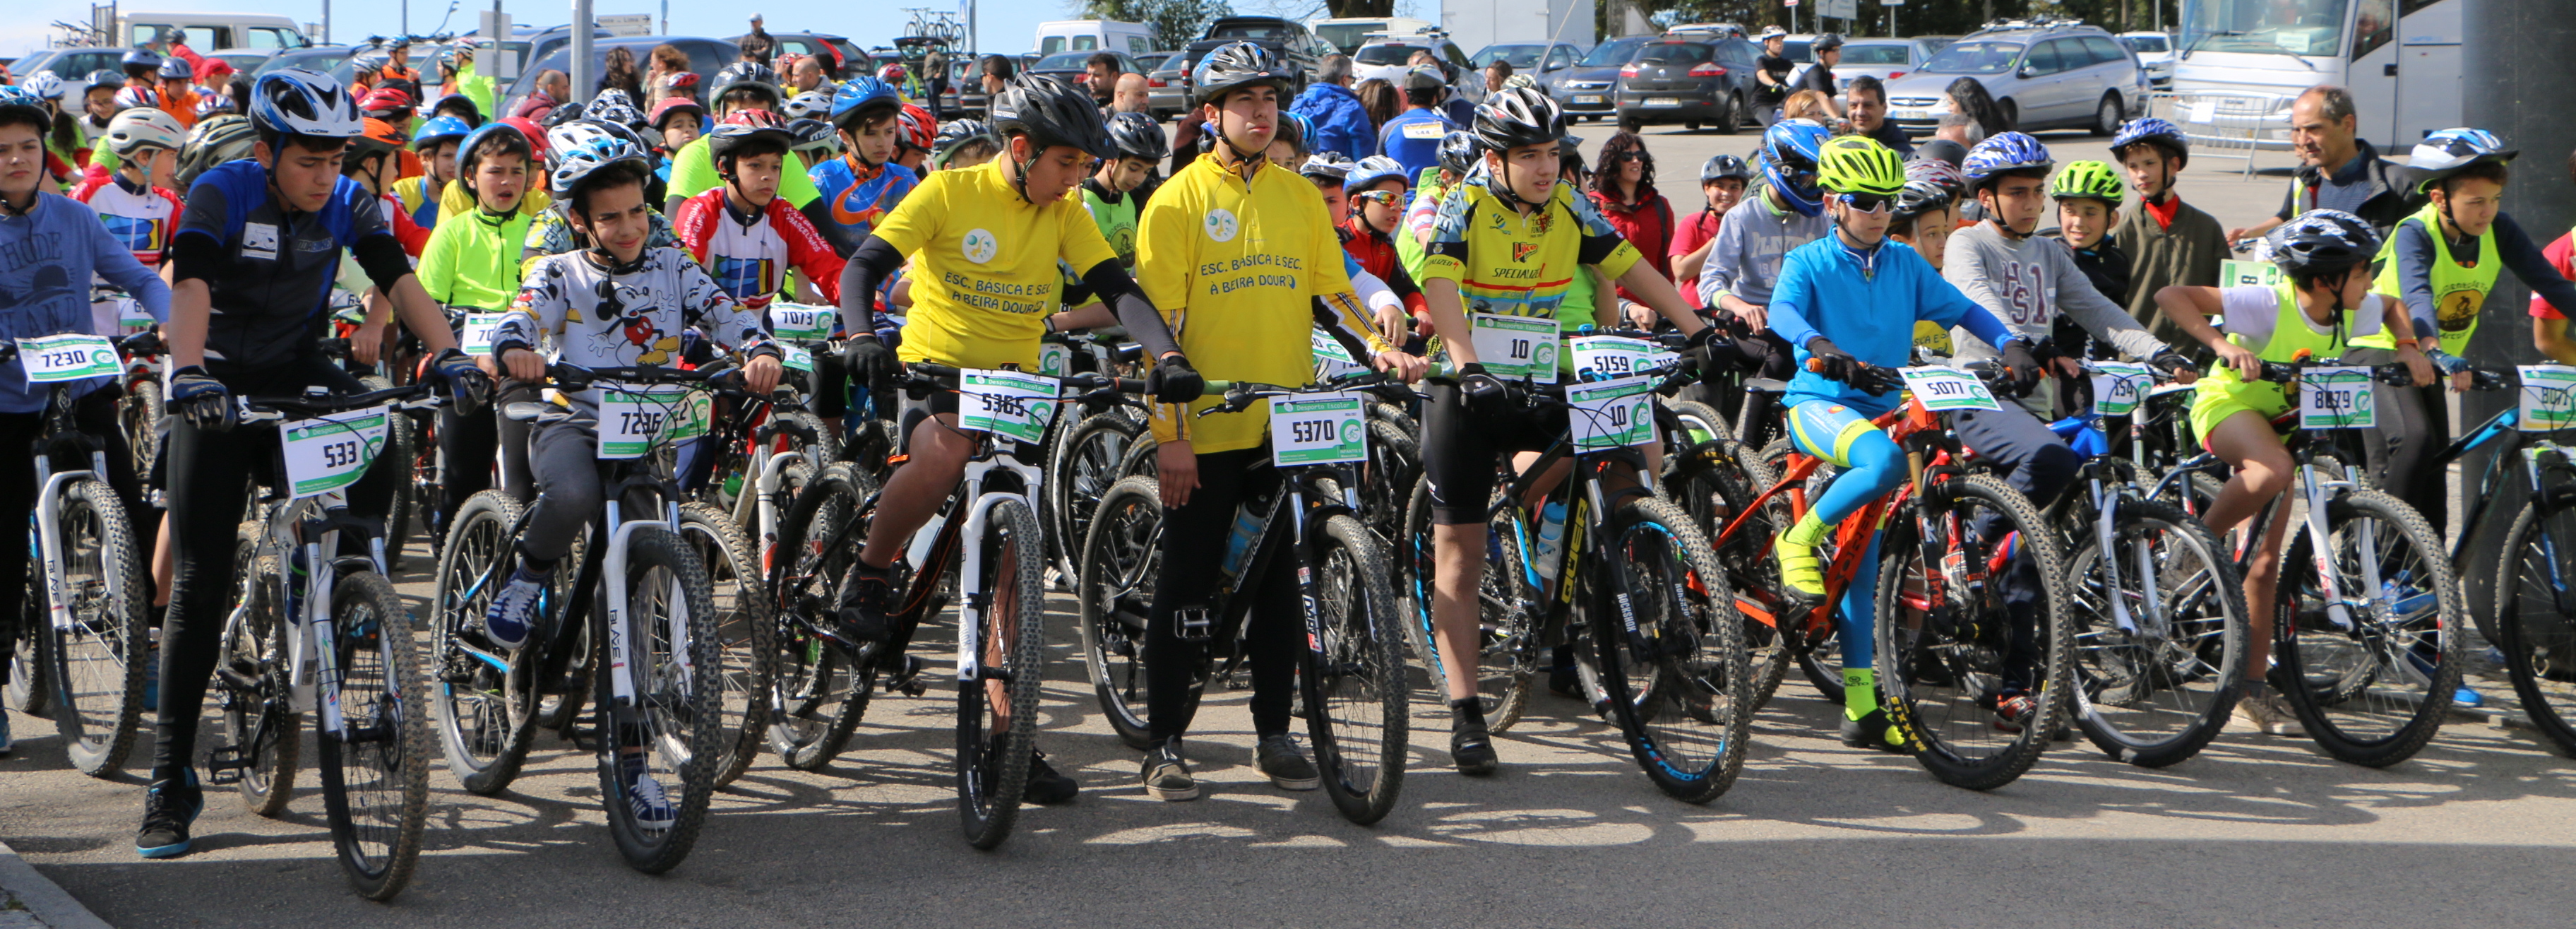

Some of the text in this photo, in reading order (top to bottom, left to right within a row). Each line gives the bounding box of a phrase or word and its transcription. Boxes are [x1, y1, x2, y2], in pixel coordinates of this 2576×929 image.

[1201, 262, 1228, 276] ESC.
[1275, 255, 1281, 266] E
[1282, 256, 1302, 270] SEC.
[945, 271, 1051, 295] ESC. BÁSICA E SEC
[1222, 276, 1255, 292] BEIRA
[964, 294, 998, 309] BEIRA
[781, 312, 813, 325] 7073
[1510, 338, 1529, 359] 10
[41, 350, 87, 367] 7230
[1594, 355, 1629, 371] 5159
[989, 379, 1046, 391] Desporto Escolar
[1592, 390, 1618, 398] Desporto
[1926, 381, 1964, 396] 5077
[1610, 405, 1627, 427] 10
[312, 425, 345, 436] Desporto
[1292, 419, 1335, 443] 5370
[323, 440, 357, 468] 533
[47, 559, 61, 603] BLAZE
[1616, 593, 1637, 632] ROCKSHOX
[609, 609, 621, 658] BLAZE
